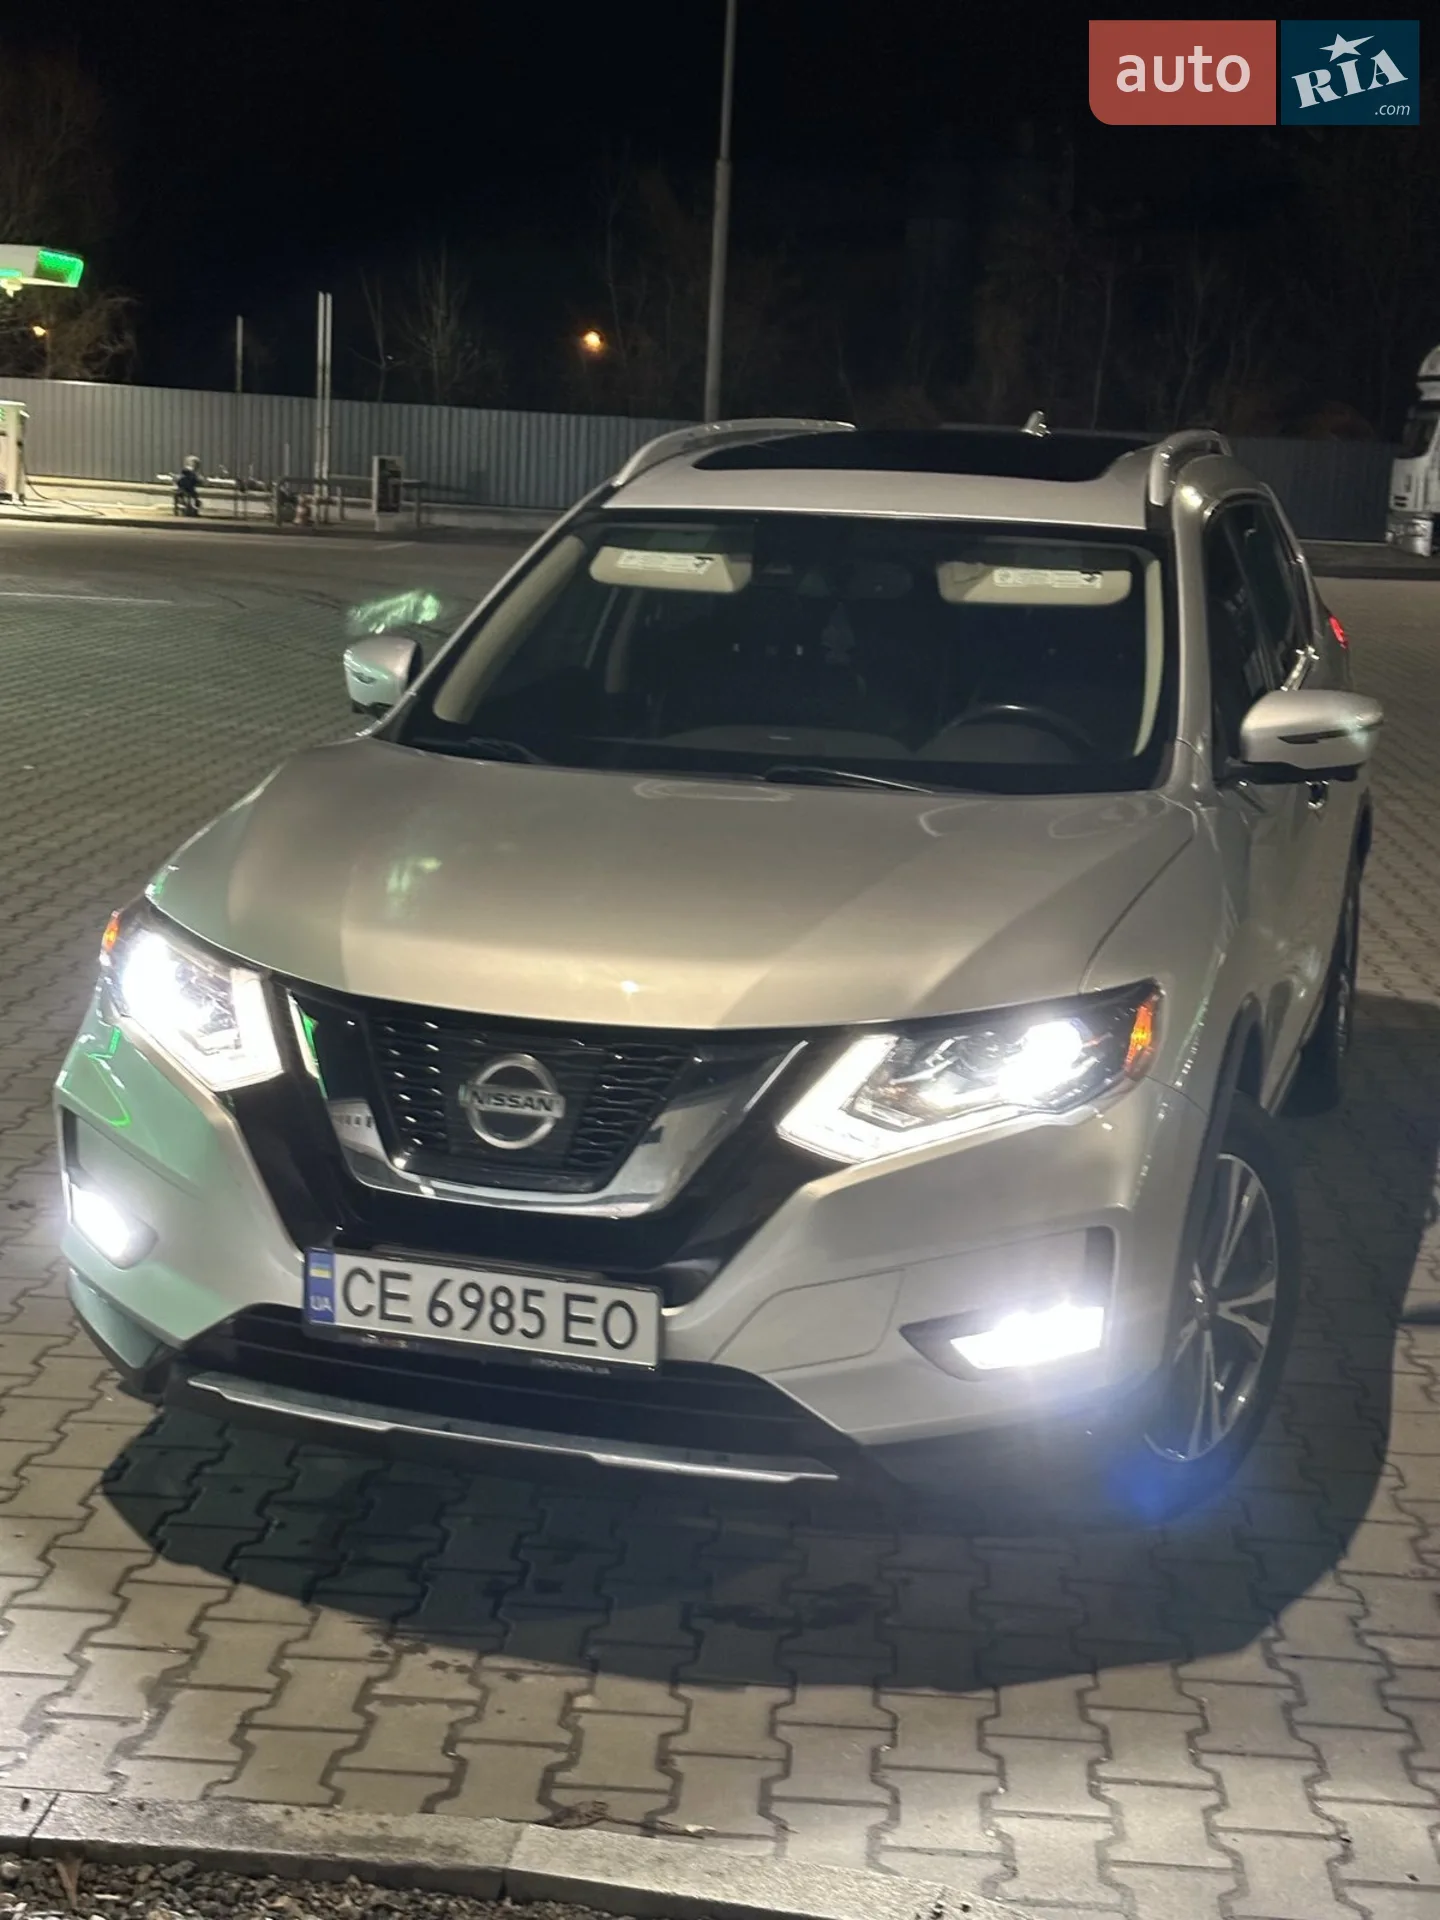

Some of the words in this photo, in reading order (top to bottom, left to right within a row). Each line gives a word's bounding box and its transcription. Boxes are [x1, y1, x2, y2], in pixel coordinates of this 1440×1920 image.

[472, 1090, 555, 1112] NISSAN
[310, 1295, 334, 1314] UA
[341, 1266, 413, 1324] CE
[427, 1278, 546, 1339] 6985
[563, 1292, 638, 1351] EO
